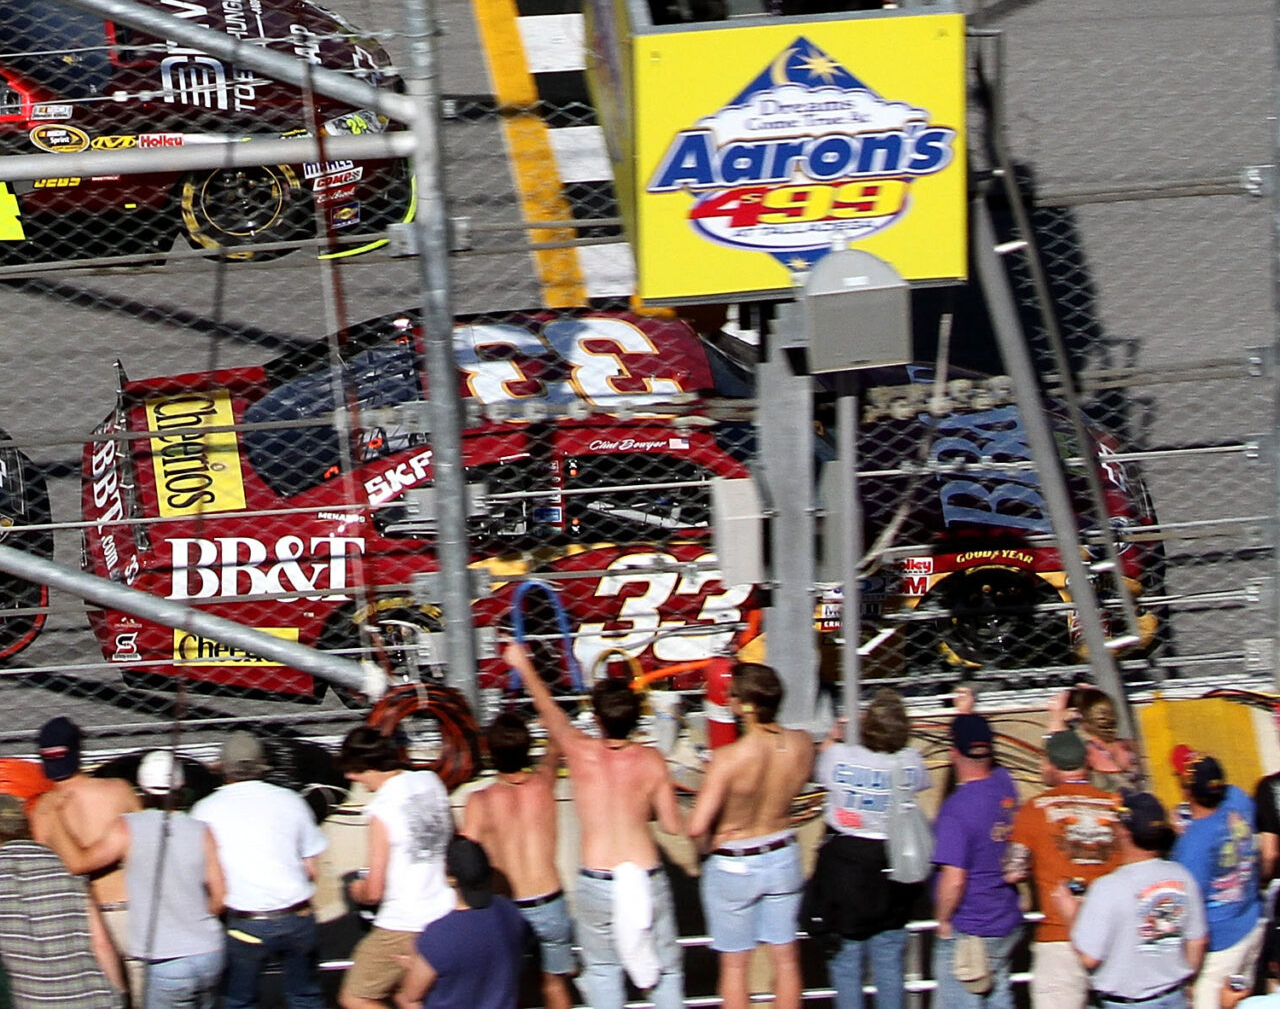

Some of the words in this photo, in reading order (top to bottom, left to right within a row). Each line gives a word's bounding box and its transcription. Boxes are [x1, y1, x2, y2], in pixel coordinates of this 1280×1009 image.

[345, 113, 369, 136] 24
[317, 172, 353, 187] COMP
[649, 127, 955, 191] Aaron's
[152, 394, 227, 510] Cheerios
[362, 449, 434, 507] SKF
[317, 511, 366, 523] MENARDS
[163, 534, 366, 603] BB&T
[955, 548, 1035, 565] GOODYEAR
[573, 552, 755, 664] 33
[178, 632, 276, 663] Chee
